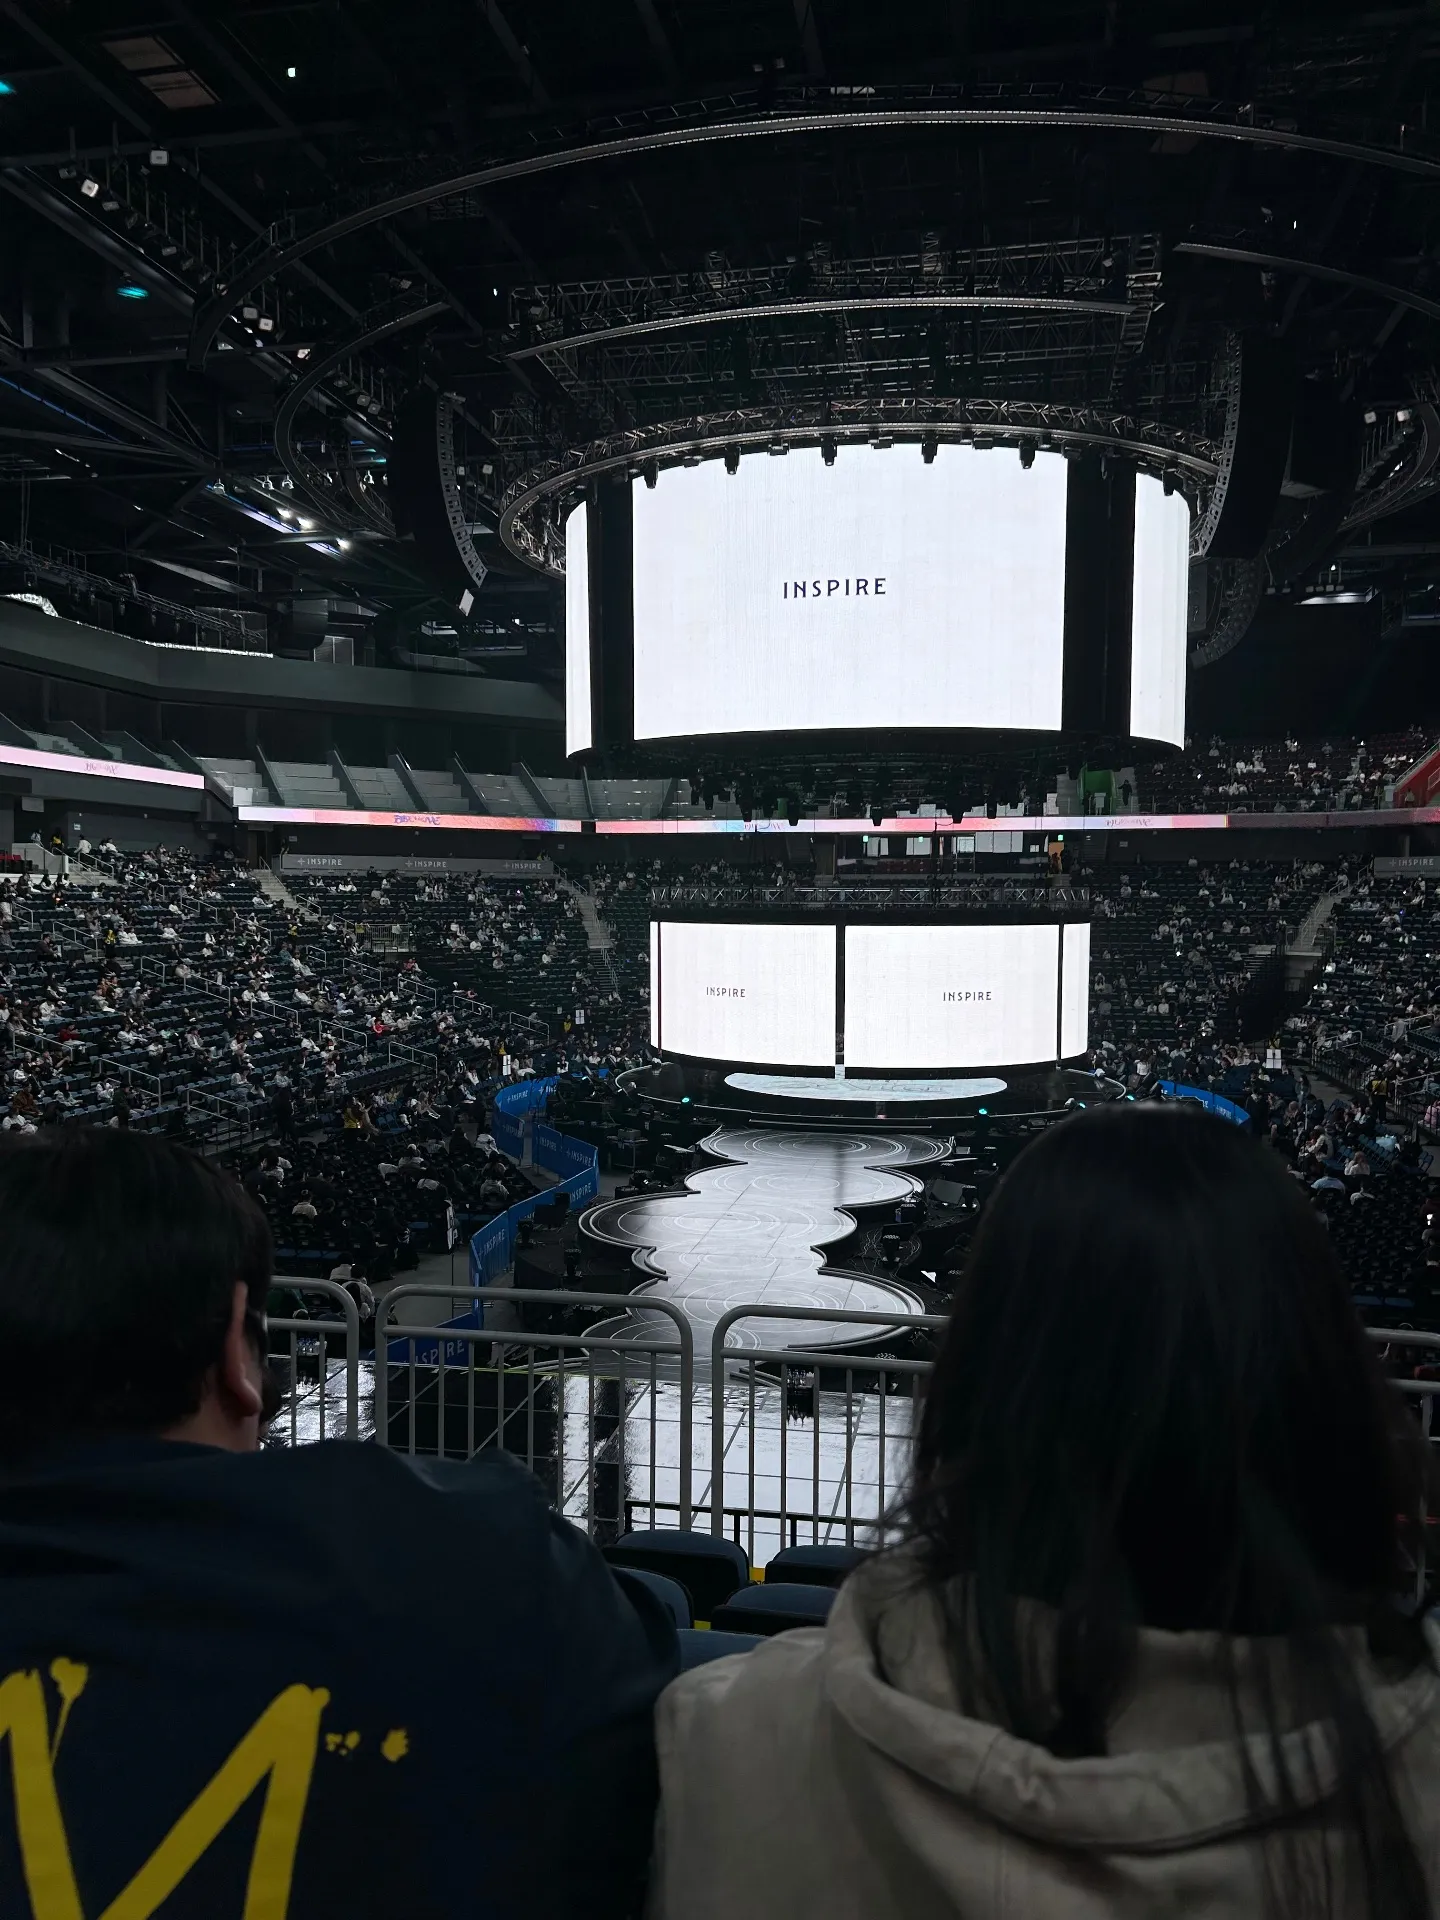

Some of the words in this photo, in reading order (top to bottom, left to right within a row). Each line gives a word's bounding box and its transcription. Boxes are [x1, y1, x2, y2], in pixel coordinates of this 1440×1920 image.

[784, 578, 886, 599] INSPIRE
[307, 858, 342, 866] INSPIRE
[1398, 858, 1434, 867] INSPIRE
[706, 987, 746, 998] INSPIRE
[943, 991, 992, 1002] INSPIRE
[571, 1150, 592, 1167] INSPIRE
[483, 1228, 505, 1256] INSPIRE
